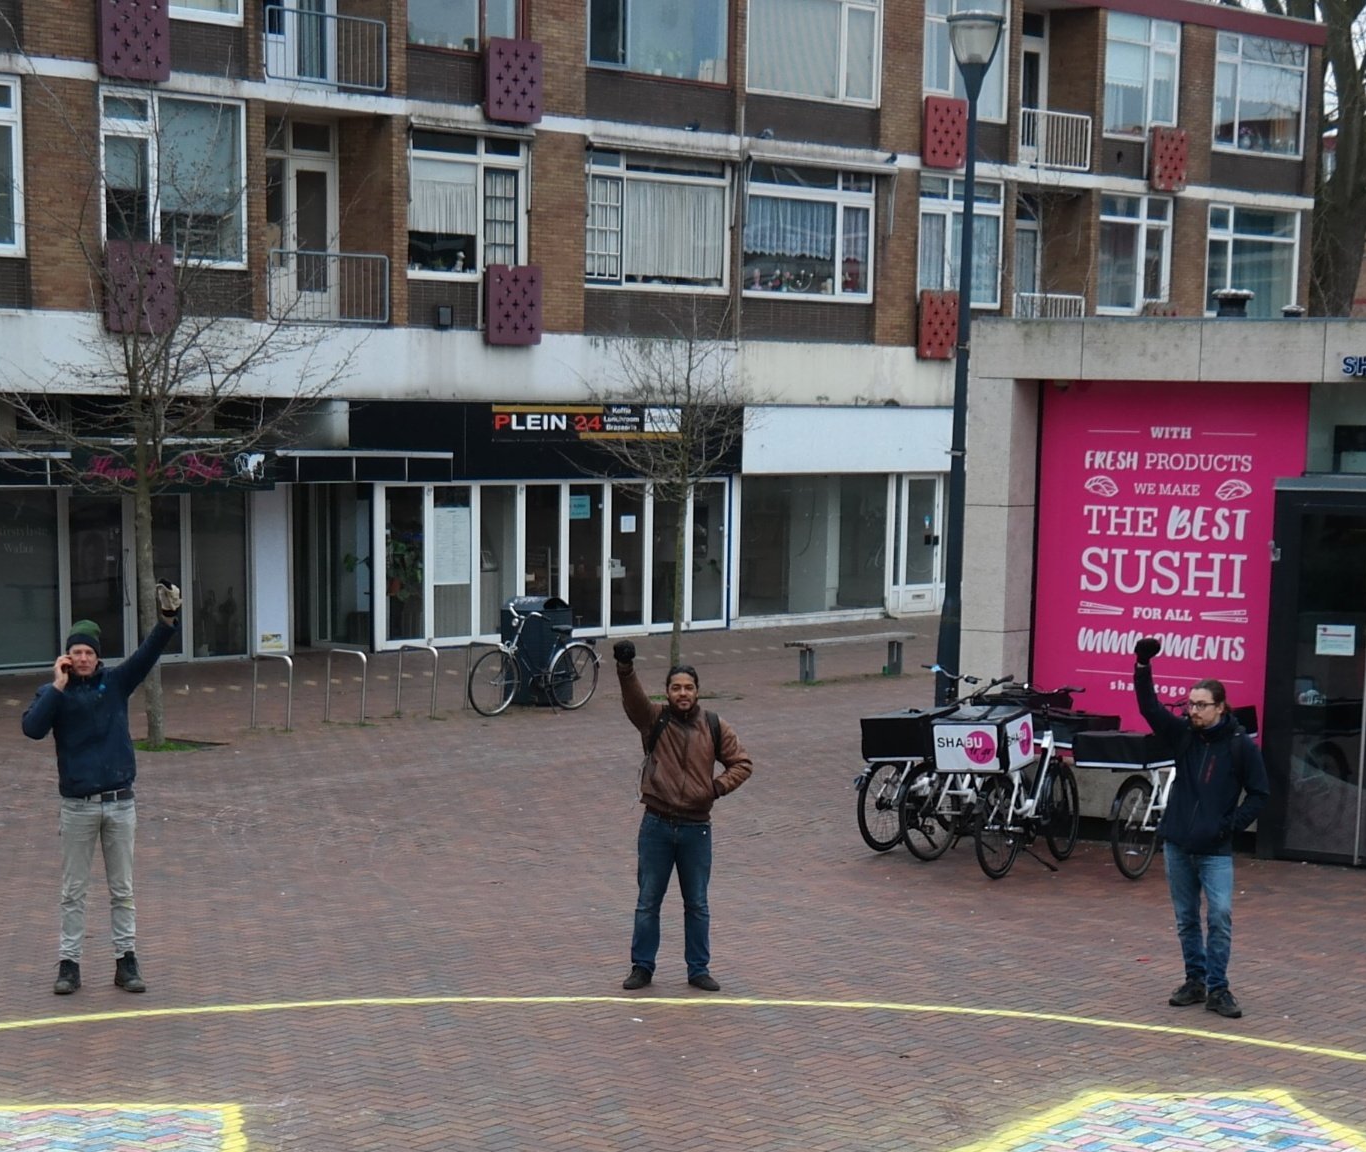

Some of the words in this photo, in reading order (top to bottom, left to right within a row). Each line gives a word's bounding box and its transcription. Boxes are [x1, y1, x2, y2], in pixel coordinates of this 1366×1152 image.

[494, 414, 567, 431] PLEIN
[574, 414, 603, 431] 24
[1150, 426, 1192, 439] WITH
[1084, 450, 1138, 471] FRESH
[1144, 452, 1253, 473] PRODUCTS
[1134, 482, 1156, 495] WE
[1158, 483, 1201, 497] MAKE
[1083, 504, 1159, 537] THE
[1166, 505, 1252, 542] BEST
[1080, 546, 1248, 599] SUSHI
[1132, 606, 1162, 620] FOR
[1164, 608, 1193, 622] ALL
[1110, 680, 1187, 697] shatogo
[937, 737, 983, 749] SHABU
